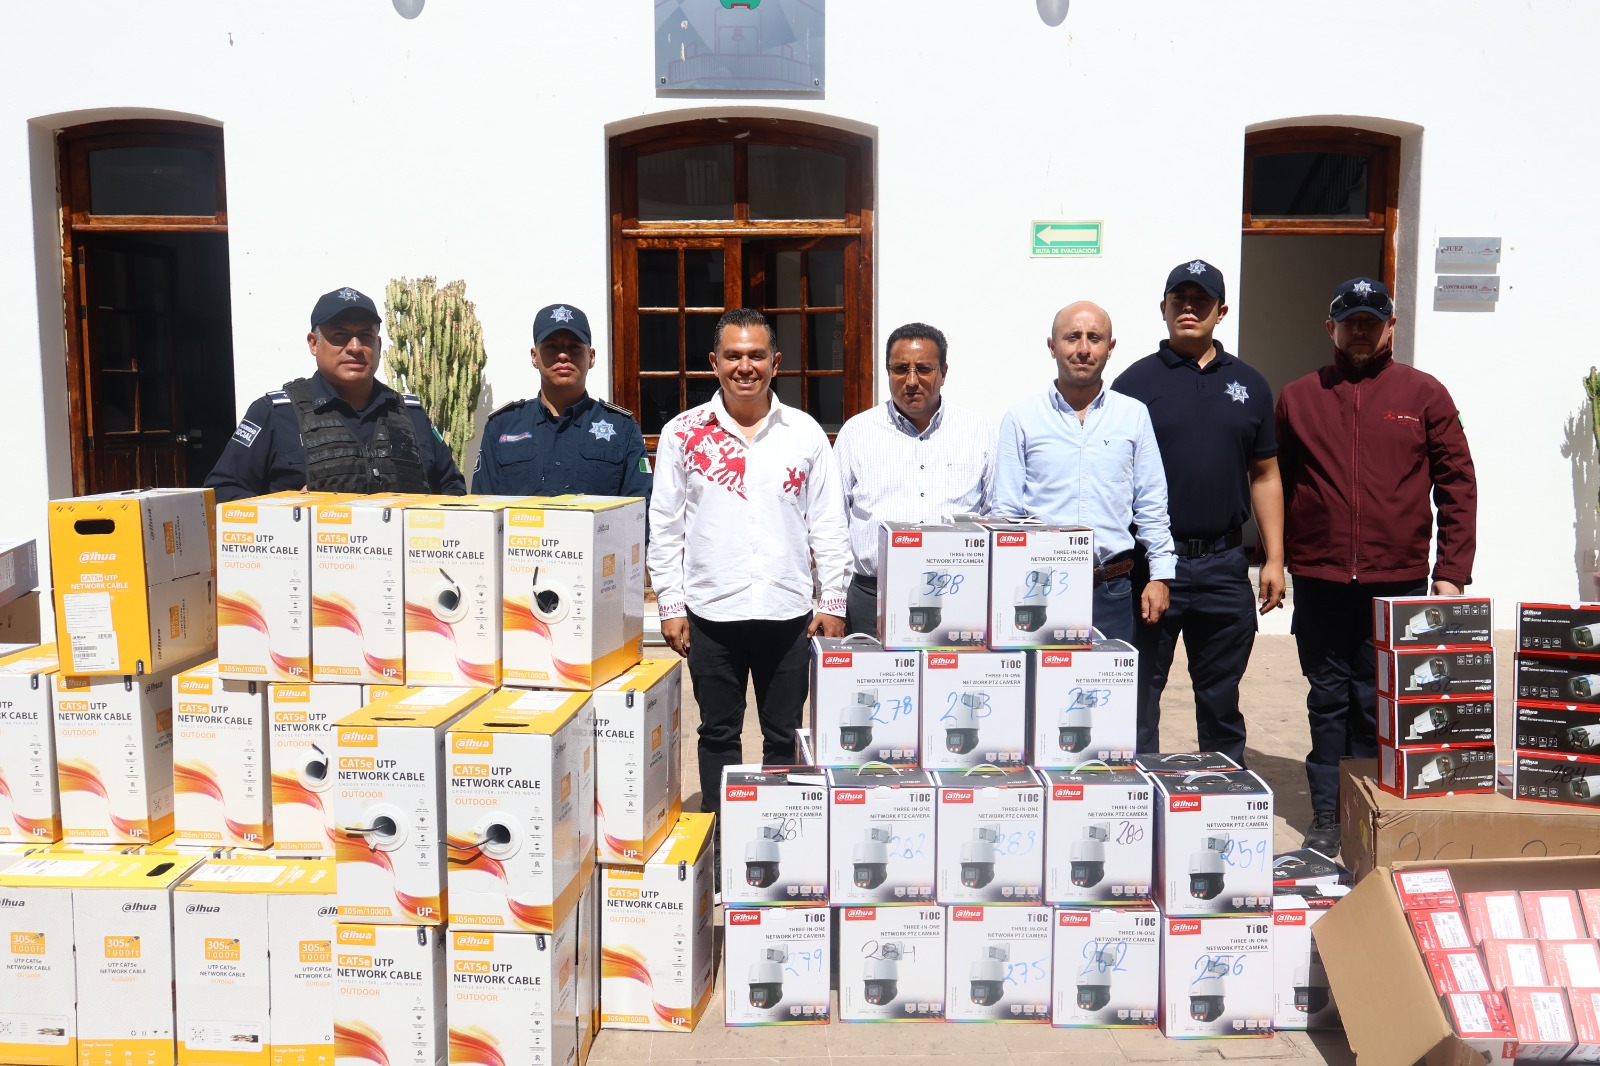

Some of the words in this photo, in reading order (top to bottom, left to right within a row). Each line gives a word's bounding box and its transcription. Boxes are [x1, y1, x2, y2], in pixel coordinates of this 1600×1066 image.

[224, 533, 252, 541] CAT5e
[256, 534, 274, 543] UTP
[318, 534, 346, 542] CAT5e
[350, 535, 368, 543] UTP
[510, 537, 539, 546] CAT5e
[542, 539, 559, 547] UTP
[442, 540, 460, 548] UTP
[222, 544, 267, 553] NETWORK
[270, 546, 299, 555] CABLE
[316, 545, 361, 554] NETWORK
[364, 547, 392, 556] CABLE
[508, 548, 553, 558] NETWORK
[554, 550, 584, 560] CABLE
[409, 550, 454, 559] NETWORK
[456, 551, 485, 560] CABLE
[71, 582, 105, 590] NETWORK
[107, 581, 129, 589] CABLE
[922, 571, 965, 597] 328
[1066, 687, 1112, 713] 253
[90, 702, 108, 710] UTP
[179, 704, 208, 713] CAT5e
[211, 705, 229, 714] UTP
[869, 695, 913, 724] 278
[58, 713, 102, 721] NETWORK
[102, 713, 132, 721] CABLE
[178, 715, 223, 724] NETWORK
[224, 716, 253, 725] CABLE
[276, 713, 305, 721] CAT5e
[308, 713, 327, 721] UTP
[274, 723, 321, 732] NETWORK
[340, 759, 372, 768] CAT5e
[376, 759, 397, 768] UTP
[338, 771, 390, 781] NETWORK
[392, 772, 425, 781] CABLE
[454, 766, 487, 775] CAT5e
[491, 767, 512, 776] UTP
[1544, 764, 1588, 784] 284
[452, 778, 505, 788] NETWORK
[507, 779, 541, 789] CABLE
[341, 790, 383, 798] OUTDOOR
[455, 797, 498, 806] OUTDOOR
[772, 816, 804, 841] 281
[1220, 839, 1267, 872] 259
[609, 889, 638, 897] CAT5e
[641, 891, 660, 899] UTP
[607, 900, 653, 909] NETWORK
[655, 902, 684, 910] CABLE
[339, 955, 371, 966] CAT5e
[374, 958, 394, 967] UTP
[784, 948, 823, 977] 279
[1080, 940, 1128, 976] 262
[456, 961, 488, 971] CAT5e
[492, 964, 513, 973] UTP
[1002, 956, 1051, 986] 275
[1192, 954, 1247, 985] 256
[337, 968, 387, 979] NETWORK
[389, 970, 423, 980] CABLE
[453, 974, 505, 984] NETWORK
[507, 976, 541, 986] CABLE
